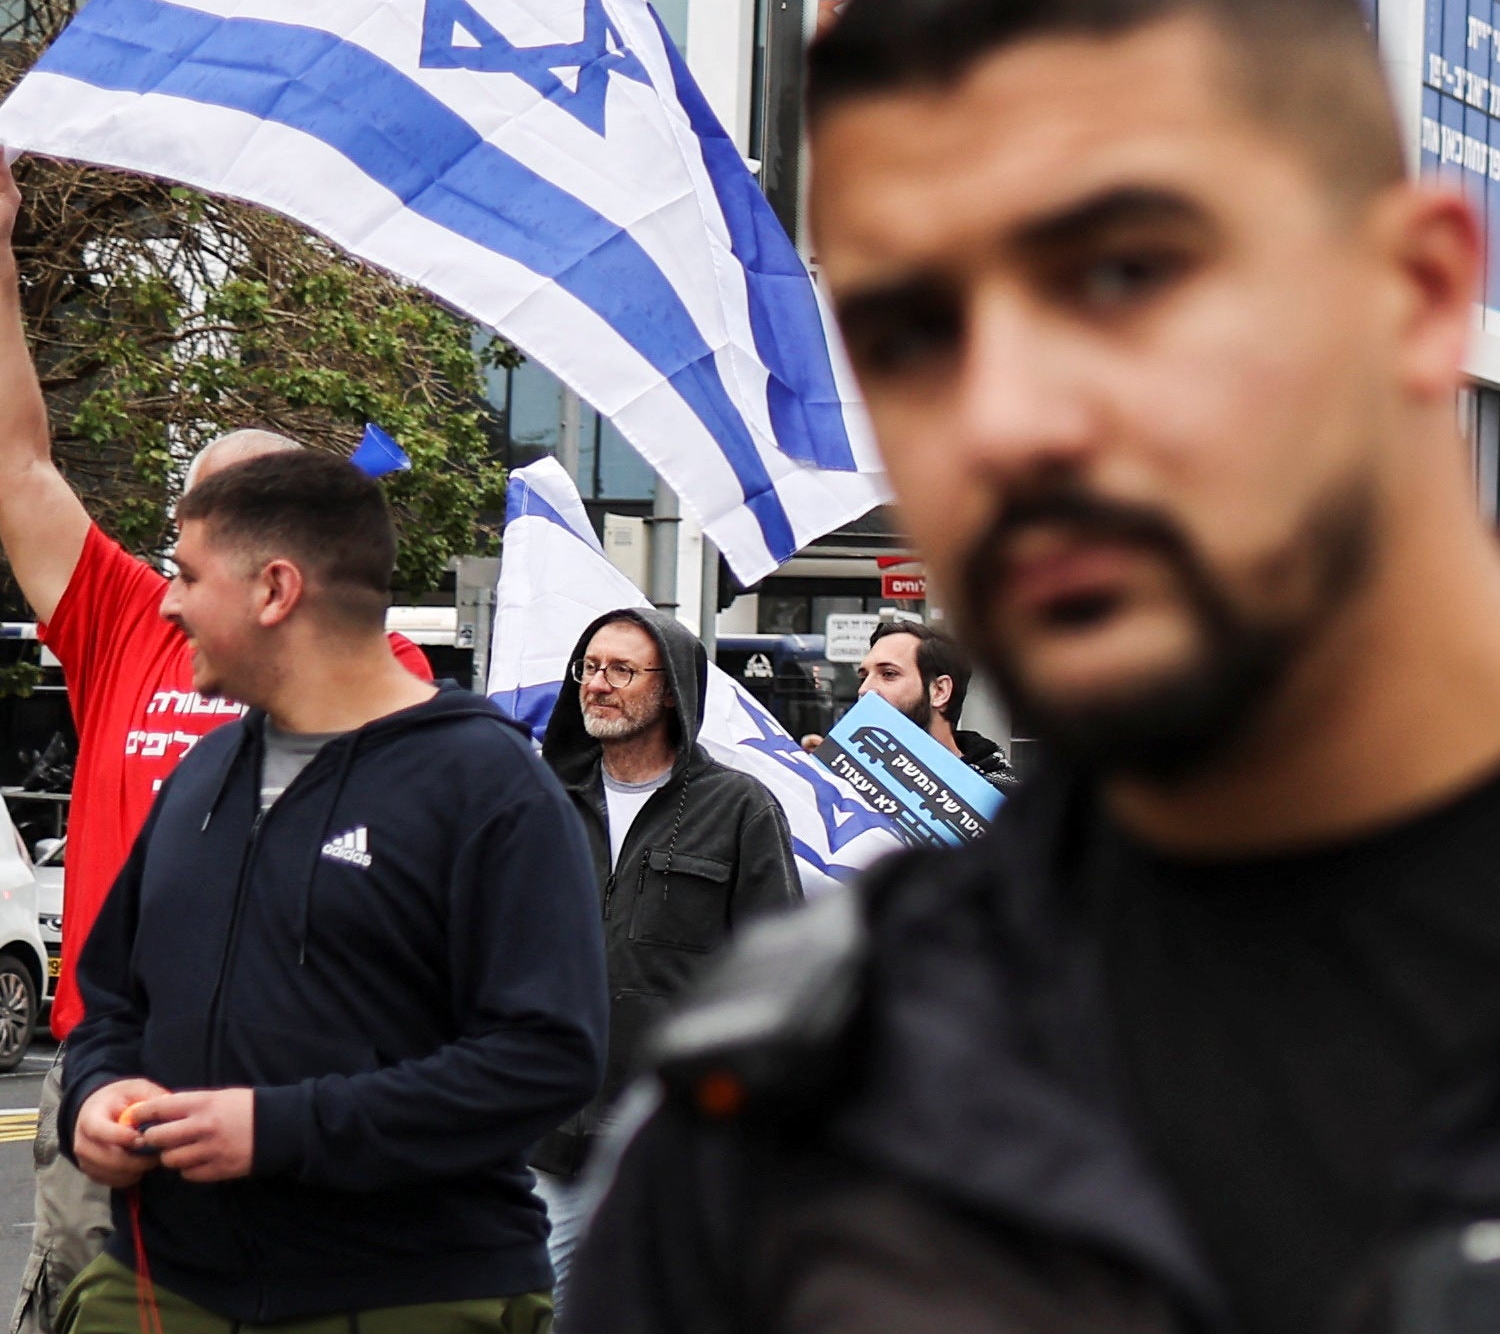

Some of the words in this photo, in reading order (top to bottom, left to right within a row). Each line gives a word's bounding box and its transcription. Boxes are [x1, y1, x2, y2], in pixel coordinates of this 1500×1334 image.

[892, 580, 928, 593] לוחים
[124, 730, 204, 758] ליפים
[830, 752, 879, 799] יעצור!
[890, 753, 938, 797] המשק
[873, 796, 899, 815] לא
[935, 788, 962, 814] של
[321, 843, 373, 867] adidas
